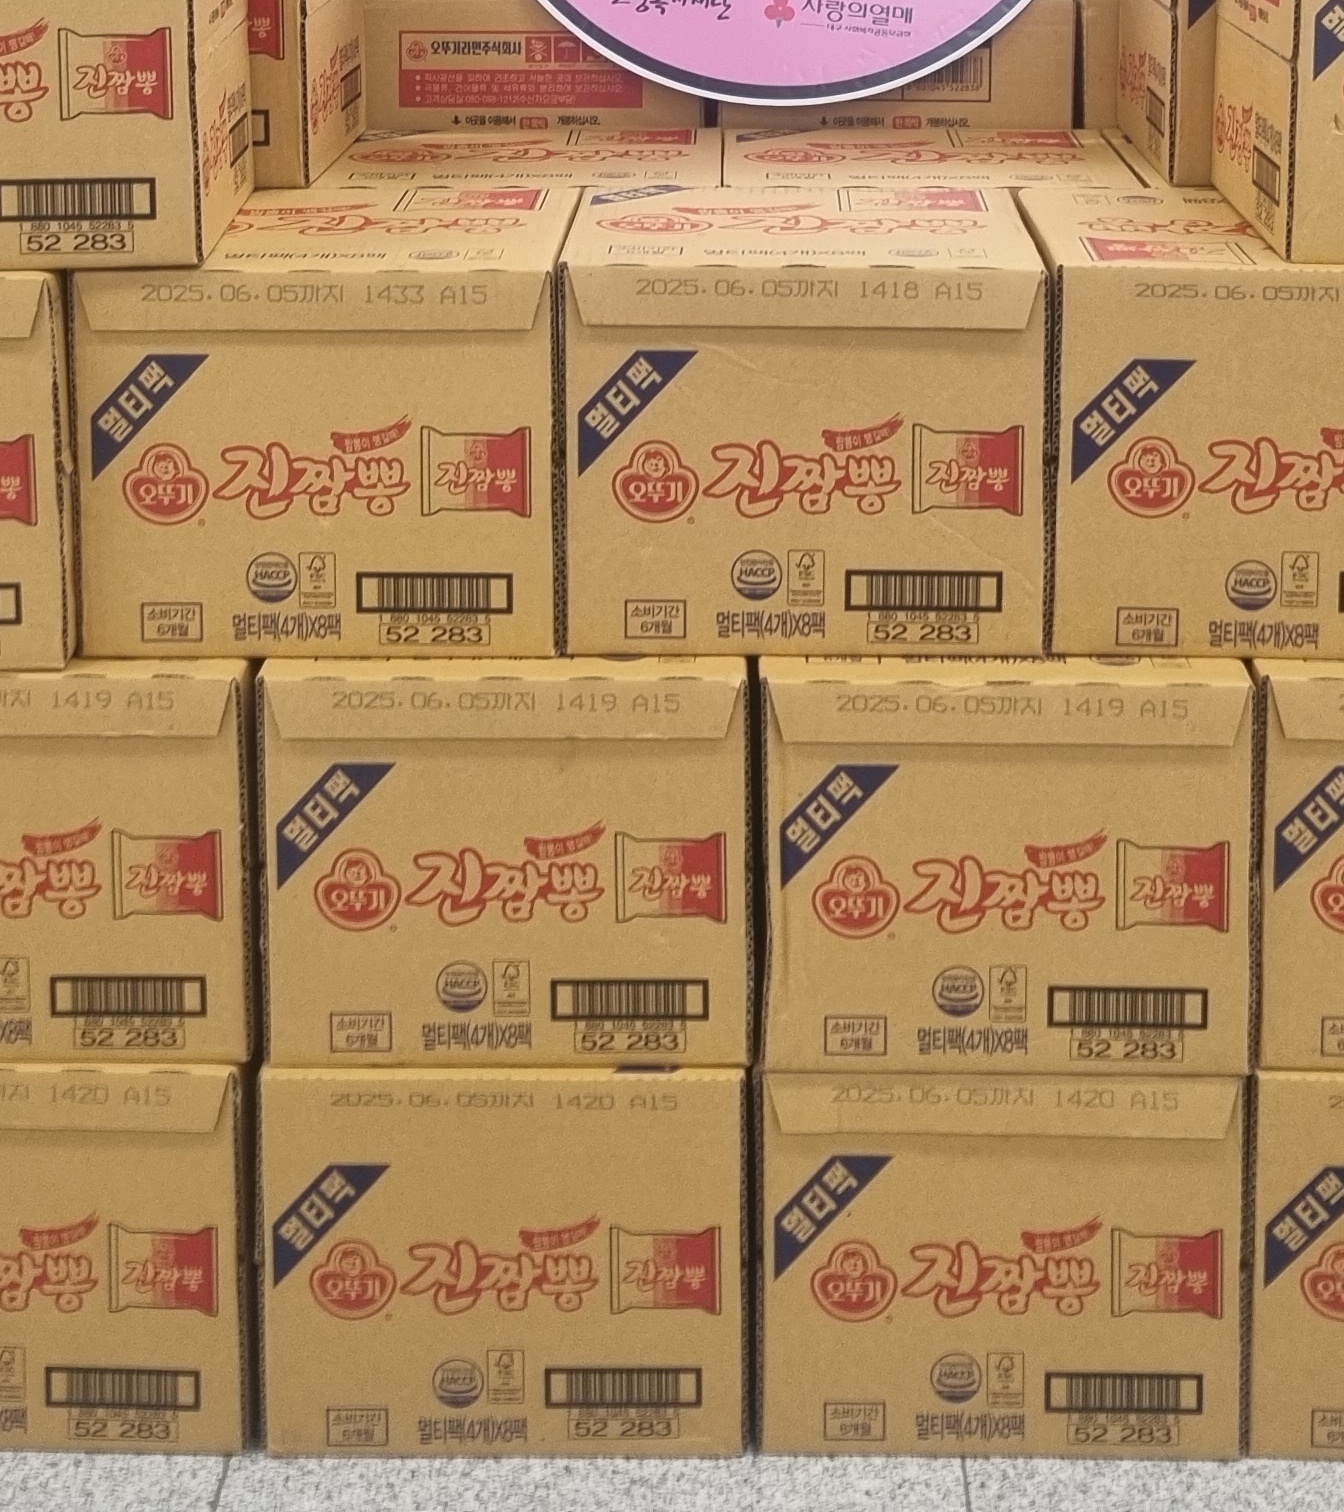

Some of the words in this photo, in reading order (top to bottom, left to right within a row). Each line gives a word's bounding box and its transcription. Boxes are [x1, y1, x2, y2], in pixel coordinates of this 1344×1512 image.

[430, 41, 522, 56] 오뚜기라면주식회사
[72, 64, 158, 99] 진짬뽕
[365, 285, 425, 304] 1433
[860, 281, 919, 300] 1418
[586, 356, 666, 441] 멀티팩
[138, 483, 195, 506] 오뚜기
[212, 441, 412, 520] 진짬뽕
[628, 480, 685, 503] 오뚜기
[701, 439, 904, 518] 진짬뽕
[1123, 476, 1181, 500] 오뚜기
[557, 691, 616, 712] 1419
[404, 847, 606, 927] 진짬뽕
[903, 855, 1108, 933] 진짬뽕
[396, 1237, 601, 1319] 진짬뽕
[900, 1240, 1102, 1319] 진짬뽕
